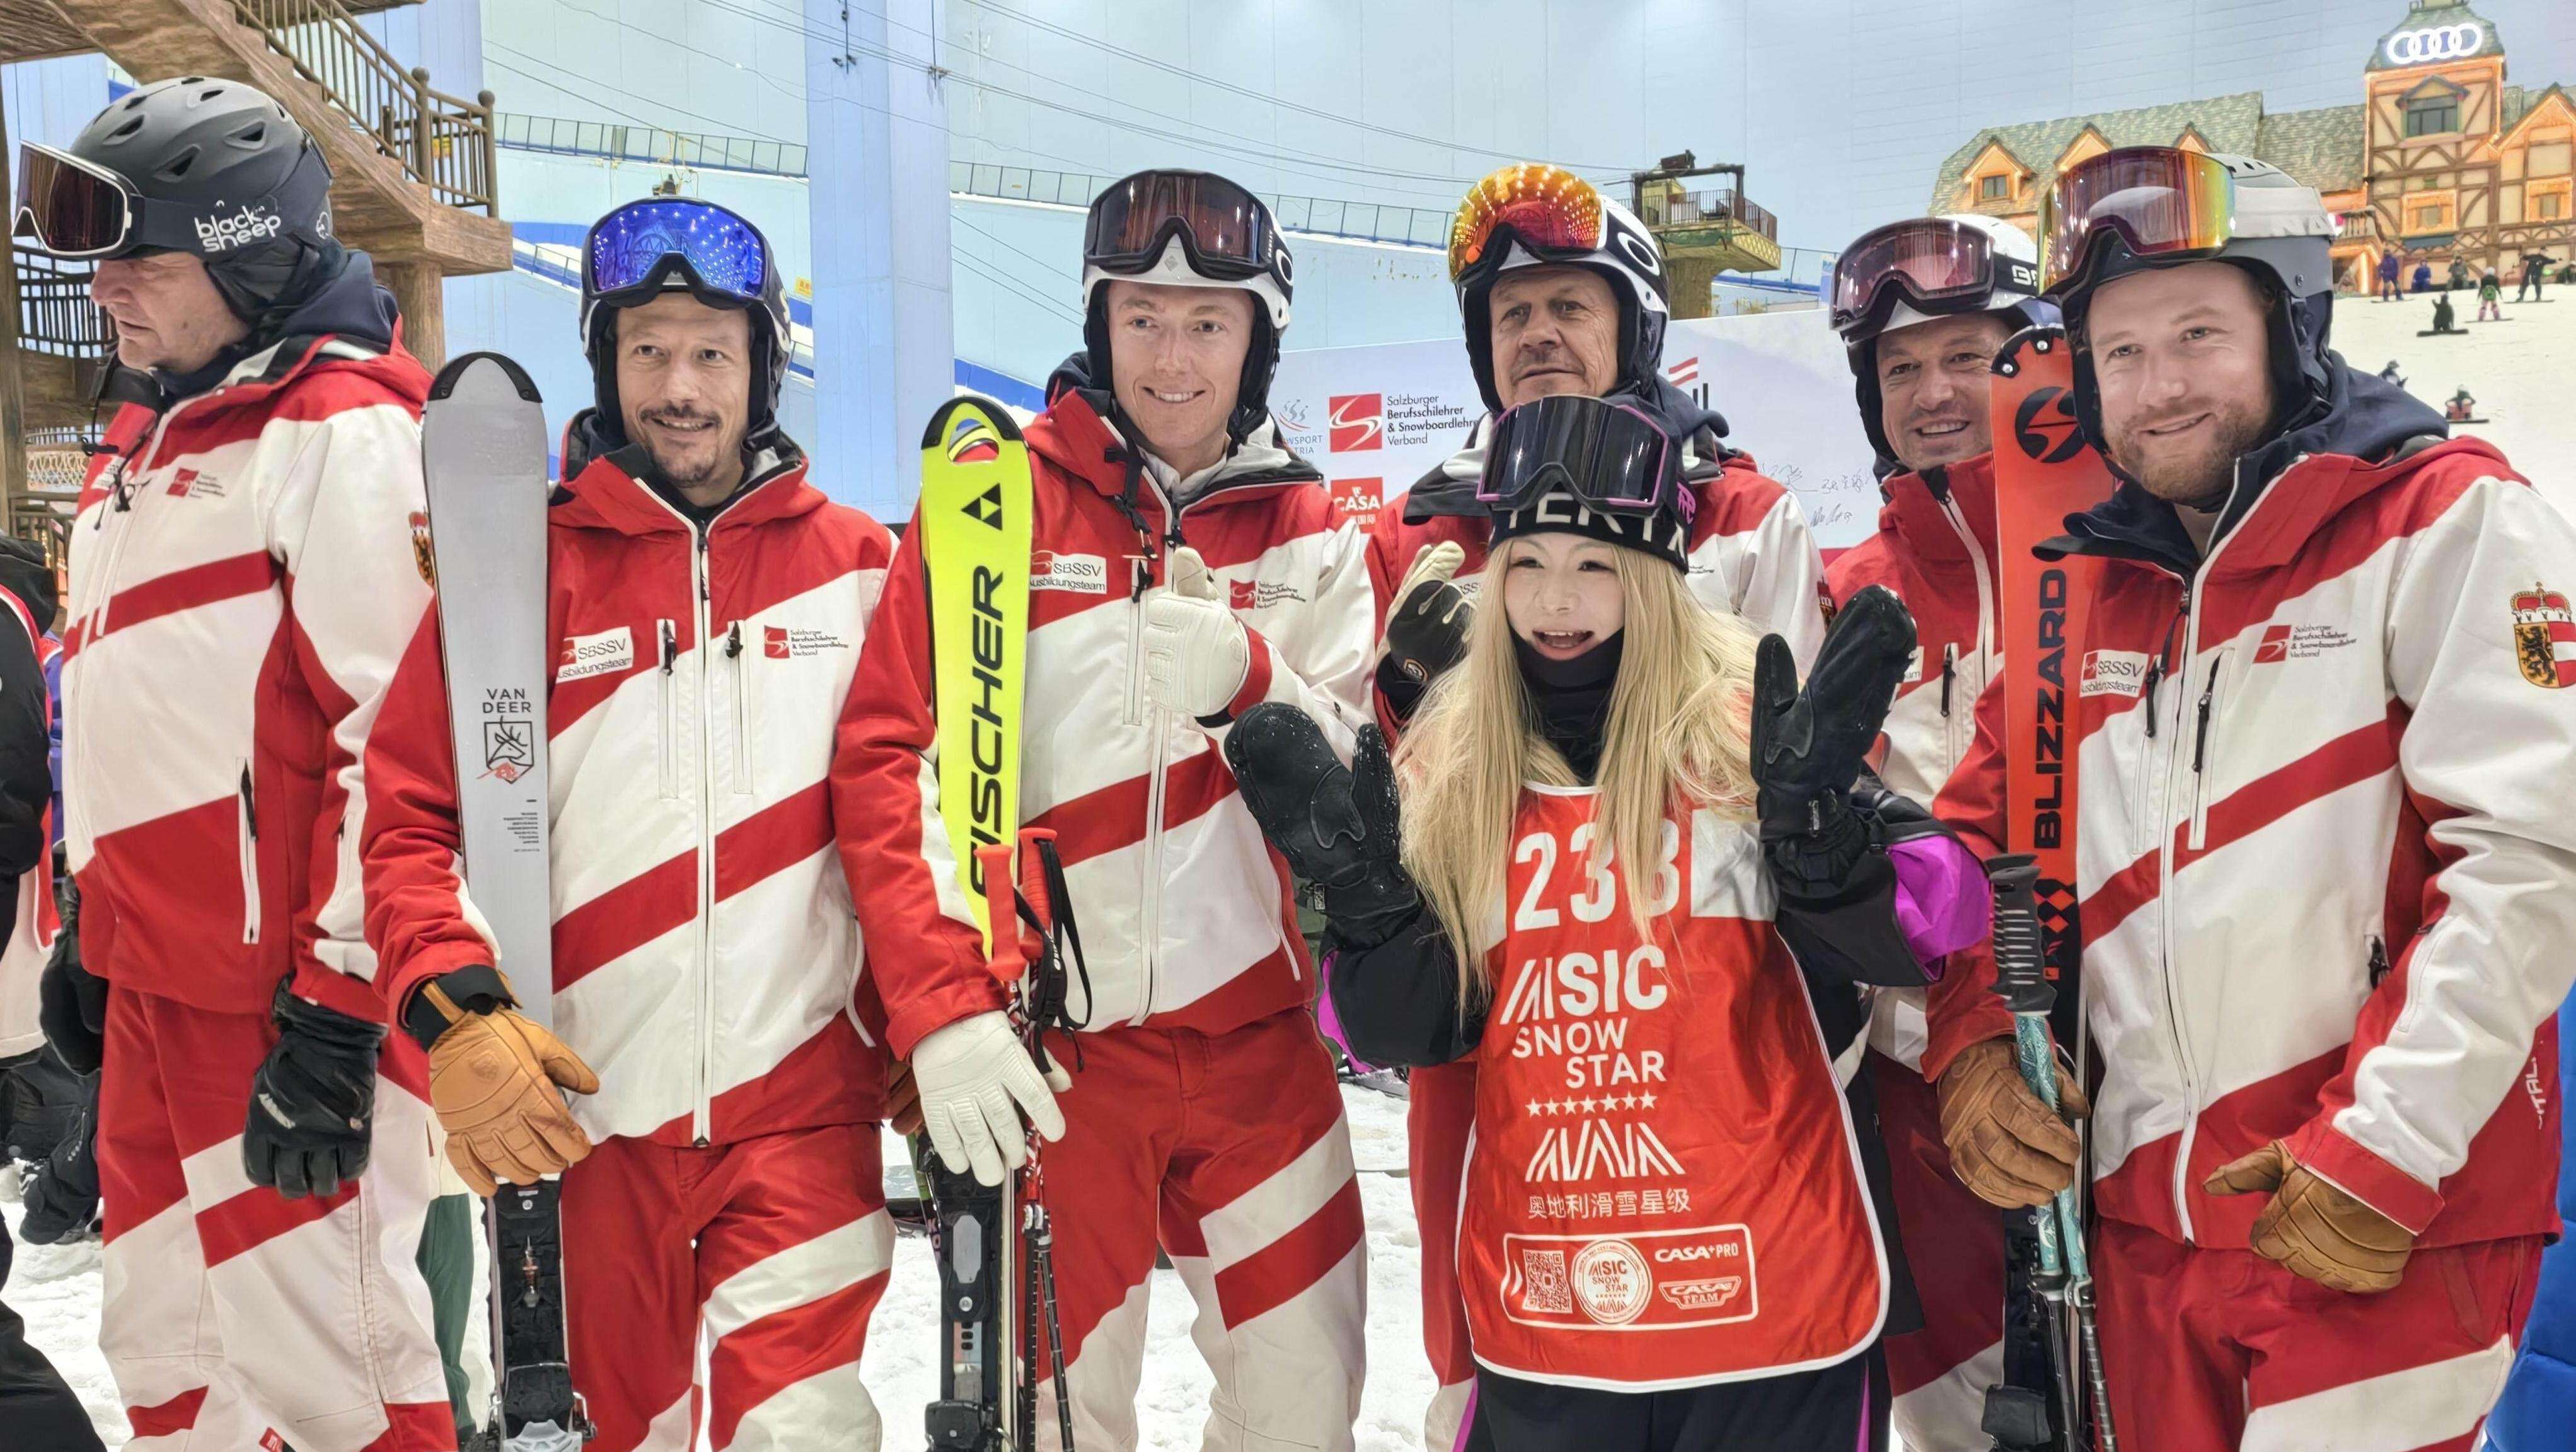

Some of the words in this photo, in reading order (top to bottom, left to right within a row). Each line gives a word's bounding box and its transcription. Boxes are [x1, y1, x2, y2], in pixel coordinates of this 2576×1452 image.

[194, 206, 262, 238] black
[202, 215, 281, 252] sheep
[1387, 394, 1439, 407] Salzburger
[1387, 405, 1464, 419] Berufsschilehrer
[1388, 423, 1395, 433] &
[1399, 417, 1479, 432] Snowboardlehr
[1288, 435, 1323, 444] NSPORT
[1388, 433, 1428, 446] Verband
[1334, 495, 1381, 512] CASA
[1053, 562, 1102, 578] SBSSV
[578, 638, 626, 659] SBSSV
[2098, 660, 2144, 677] SBSSV
[487, 688, 525, 699] VAN
[483, 702, 531, 713] DEER
[2034, 569, 2066, 849] BLIZZARD
[1512, 1018, 1628, 1059] SNOW
[1566, 1050, 1667, 1089] STAR
[1528, 1188, 1692, 1220] 奥地利滑雪星级
[1592, 1276, 1620, 1284] SNOW
[1605, 1284, 1629, 1292] STAR
[1682, 1293, 1719, 1304] TEAM
